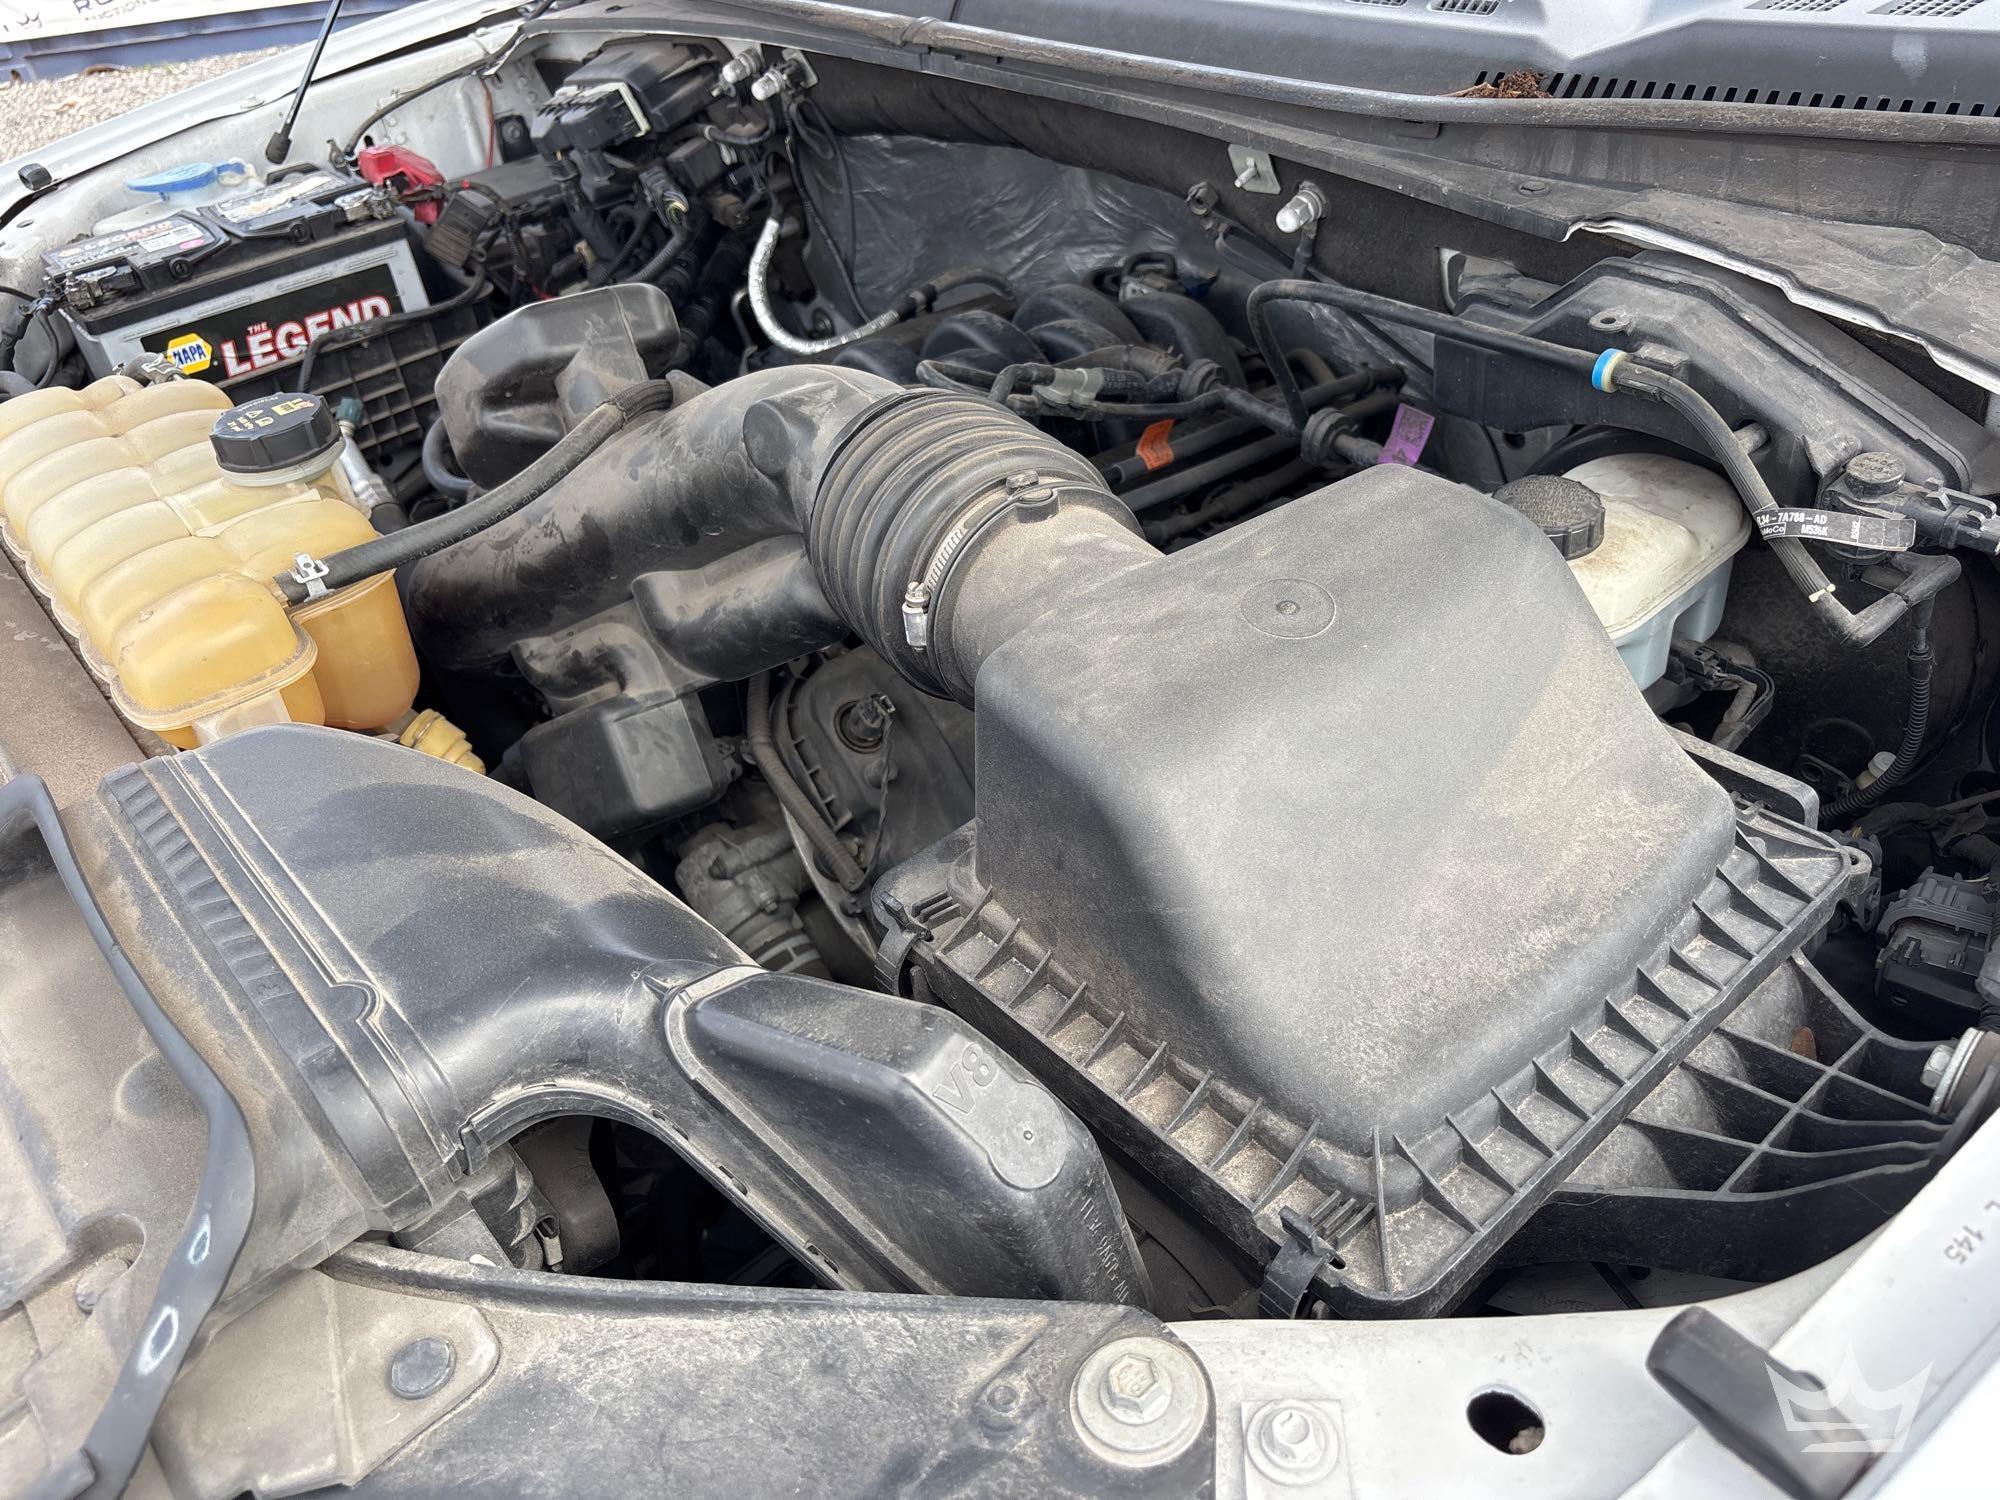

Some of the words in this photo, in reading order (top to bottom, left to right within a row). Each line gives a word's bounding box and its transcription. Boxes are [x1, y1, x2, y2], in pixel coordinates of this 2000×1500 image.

[220, 295, 393, 379] LEGEND
[247, 321, 268, 335] THE
[172, 345, 206, 367] NAPA
[931, 1040, 1000, 1116] V8
